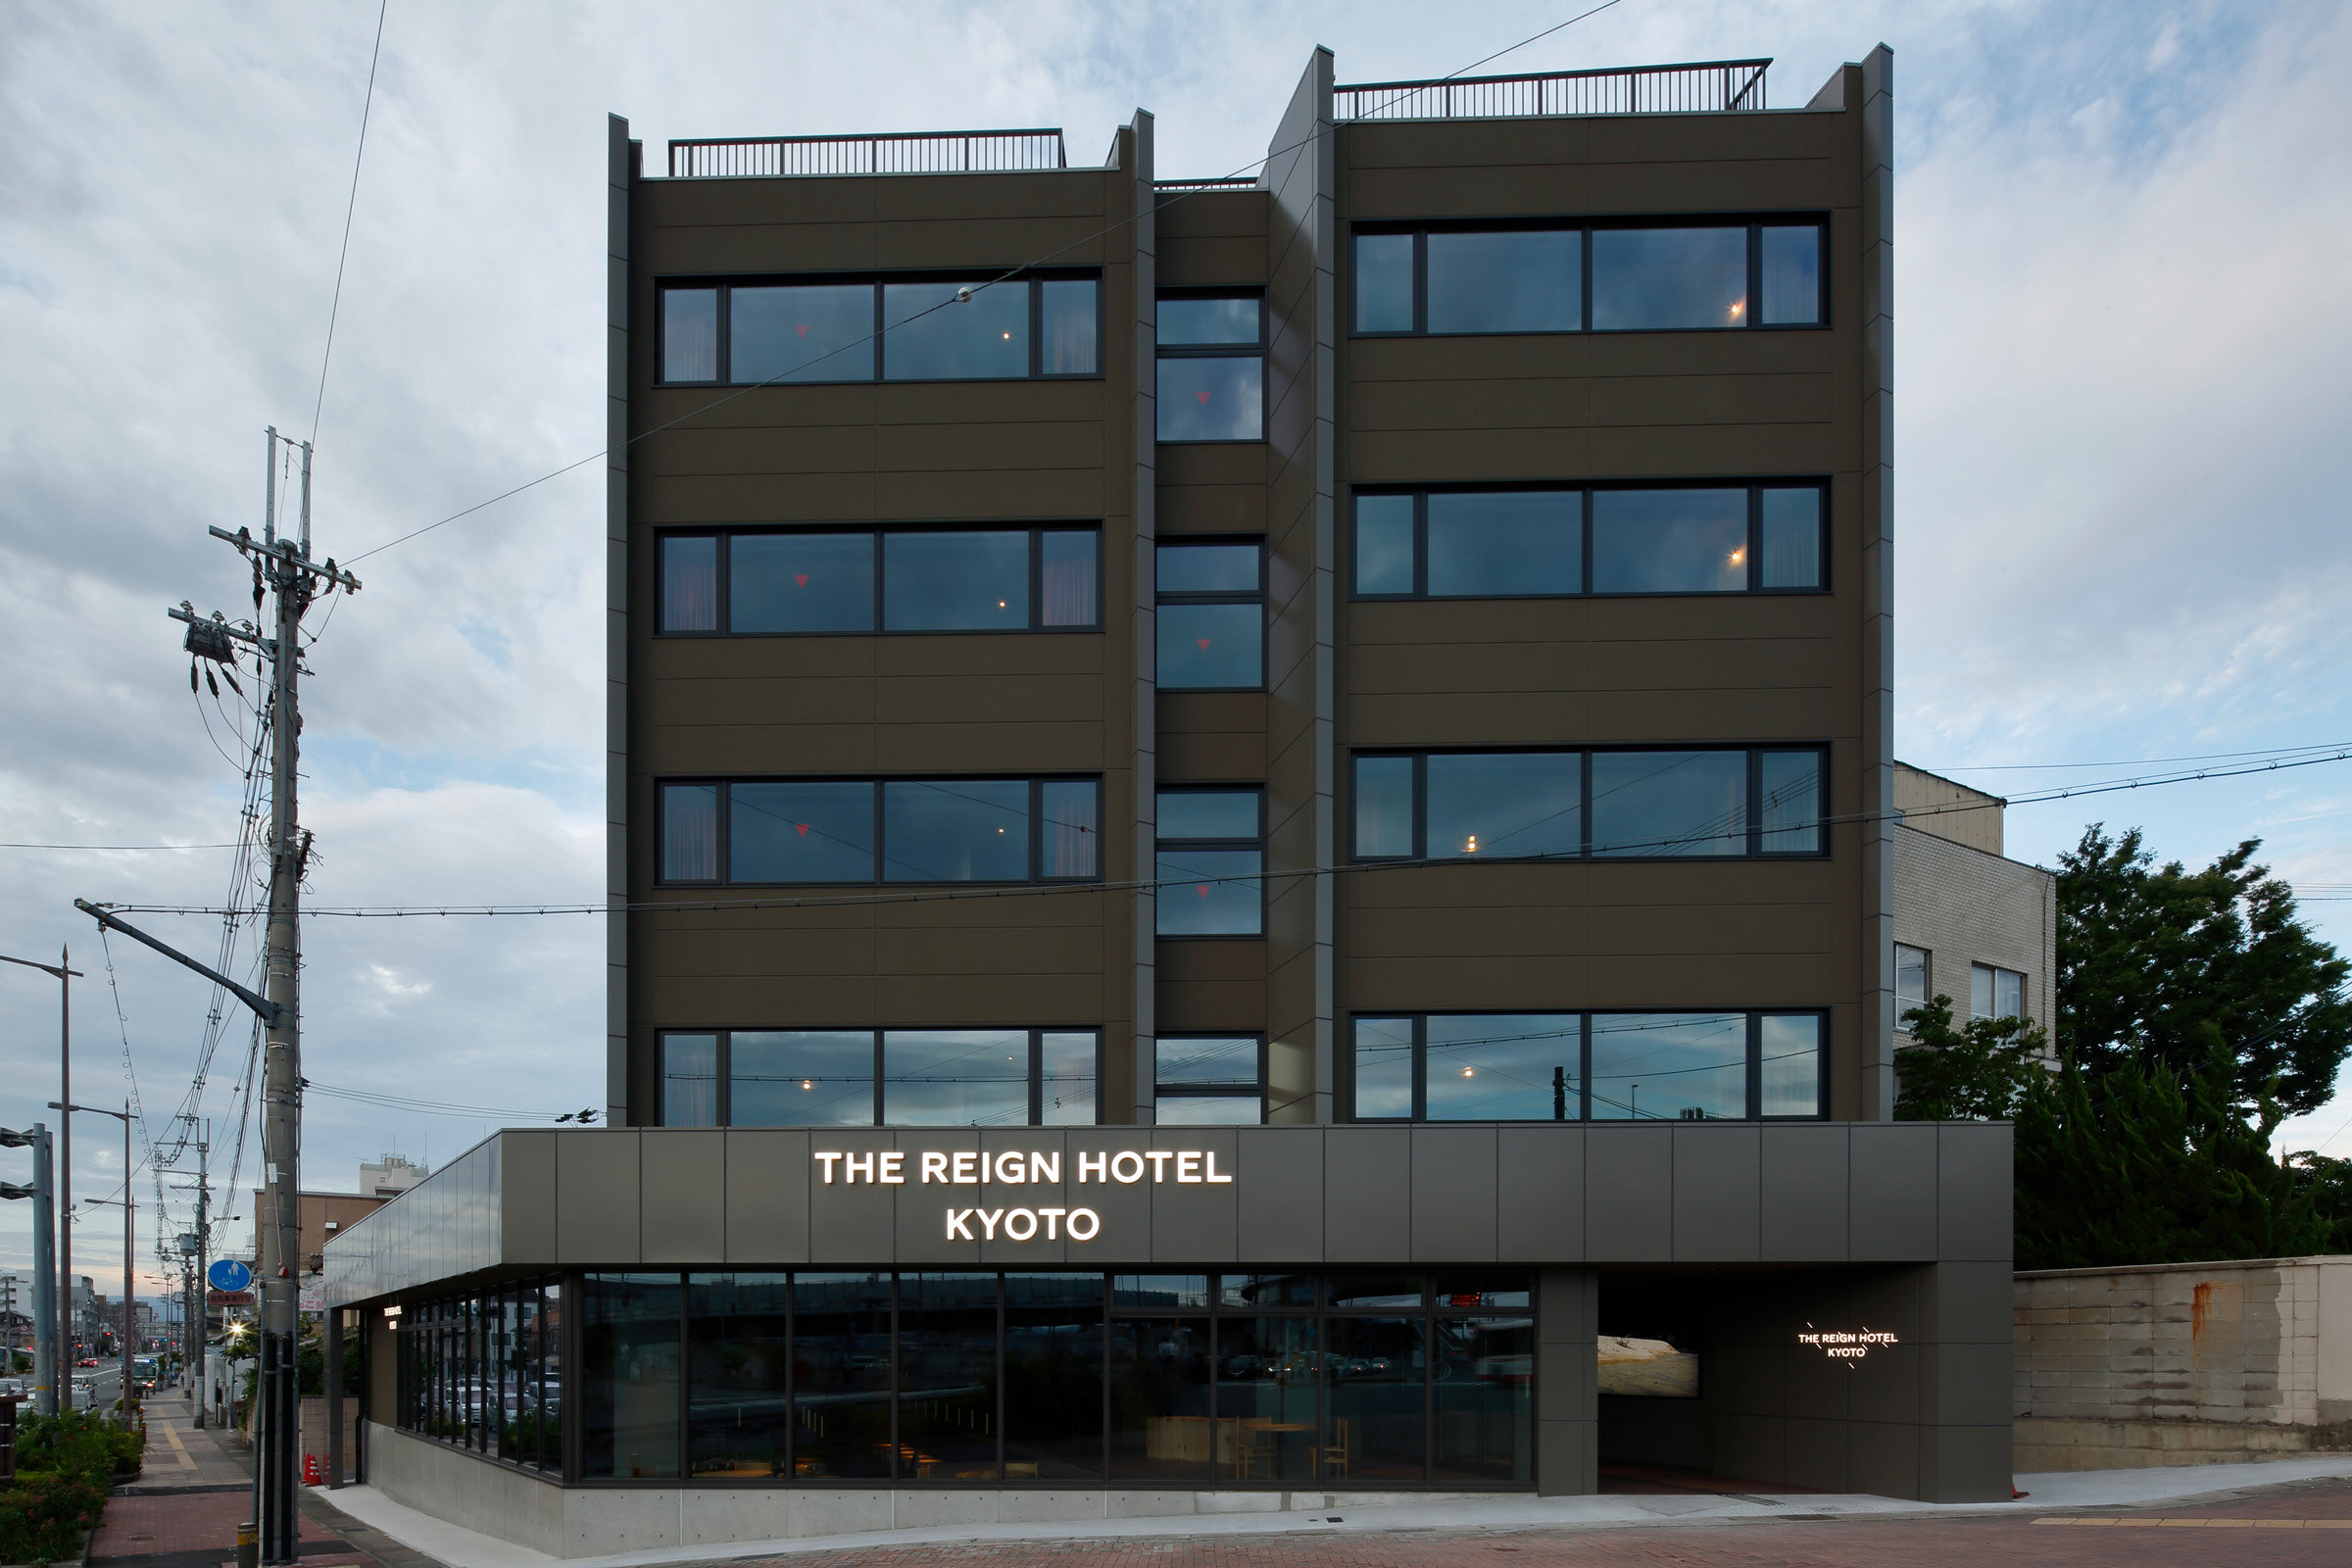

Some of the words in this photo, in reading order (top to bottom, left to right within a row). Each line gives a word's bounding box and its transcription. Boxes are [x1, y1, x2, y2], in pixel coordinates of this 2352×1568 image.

[813, 1152, 905, 1184] THE
[921, 1152, 1060, 1184] REIGN
[1078, 1151, 1233, 1184] HOTEL
[946, 1207, 1101, 1241] KYOTO
[1797, 1334, 1819, 1343] THE
[1822, 1334, 1855, 1343] REIGN
[1858, 1333, 1898, 1343] HOTEL
[1827, 1348, 1865, 1357] KYOTO
